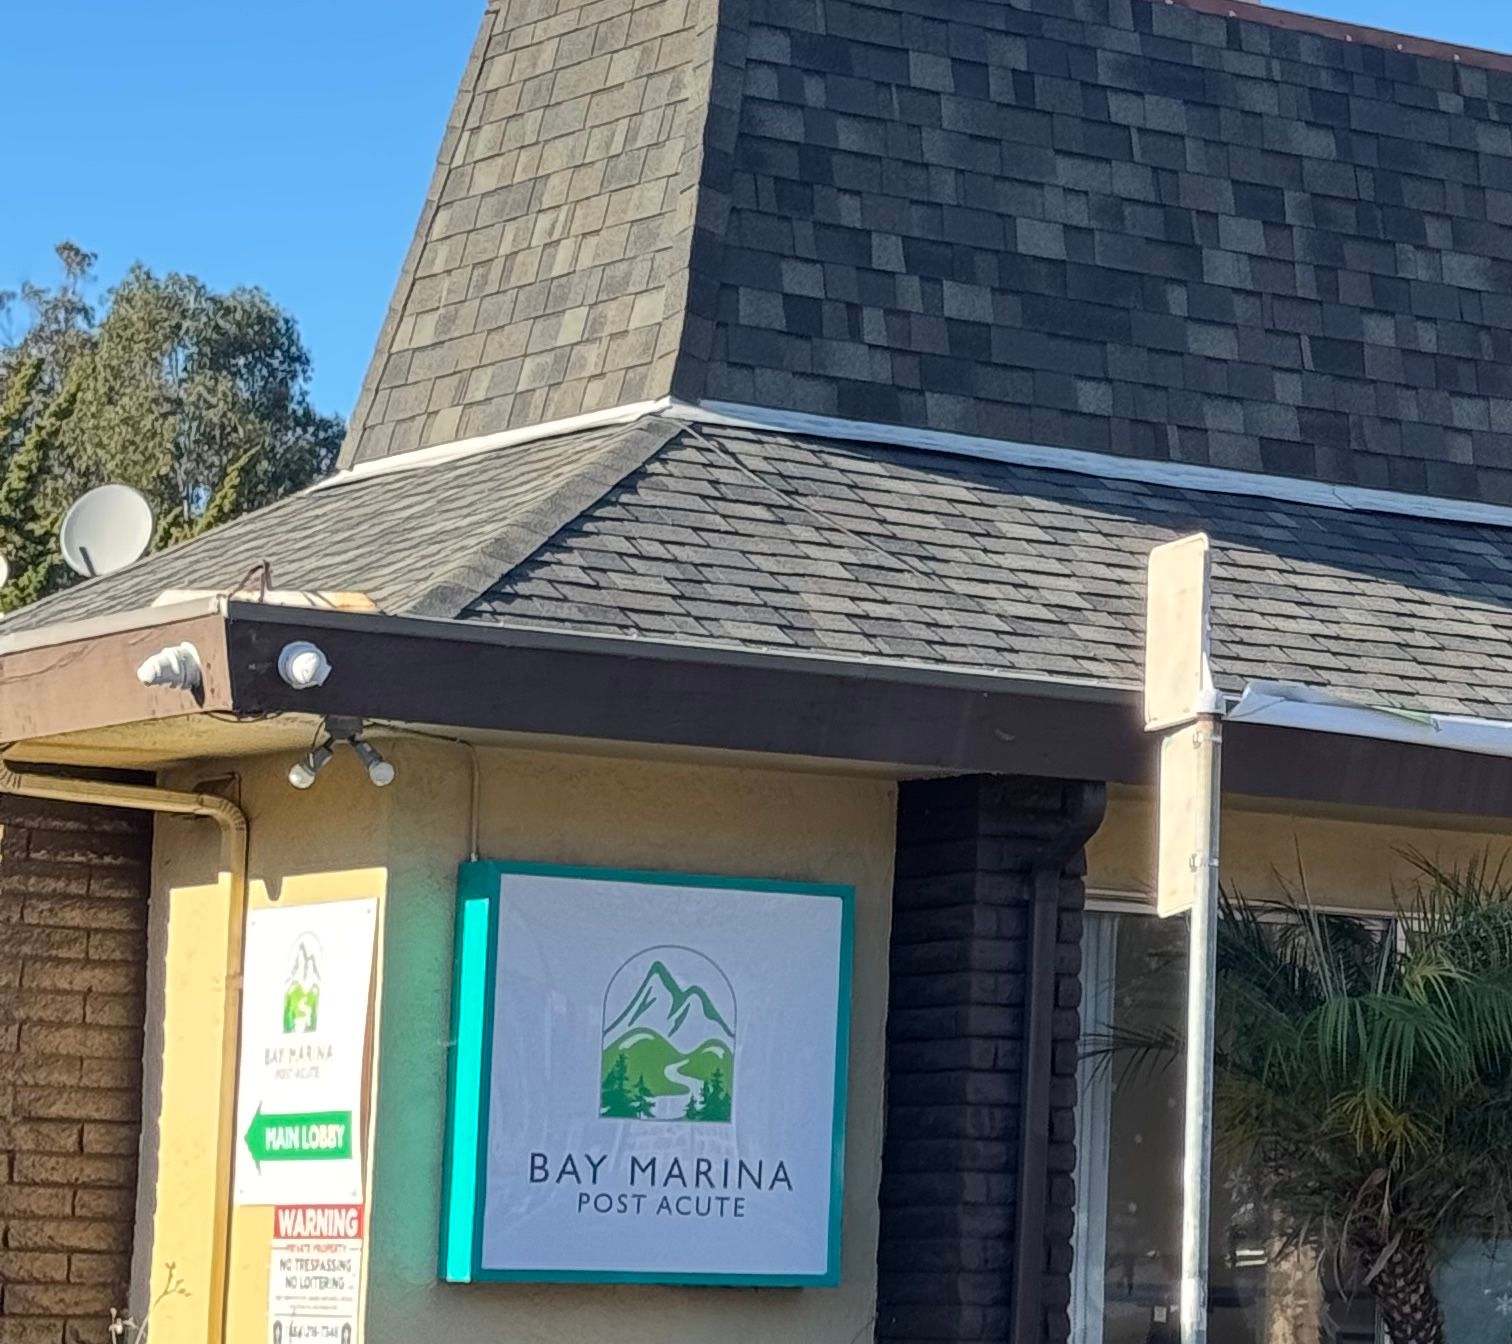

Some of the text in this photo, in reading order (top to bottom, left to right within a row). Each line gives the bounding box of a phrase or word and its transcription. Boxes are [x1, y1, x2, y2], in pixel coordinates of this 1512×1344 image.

[265, 1124, 346, 1151] MAIN LOBBY
[528, 1152, 793, 1191] BAY MARINA
[578, 1192, 746, 1218] POST ACUTE
[278, 1208, 359, 1238] WARNING
[280, 1257, 352, 1273] NO TRESPASSING
[285, 1275, 345, 1291] NO LOITERING
